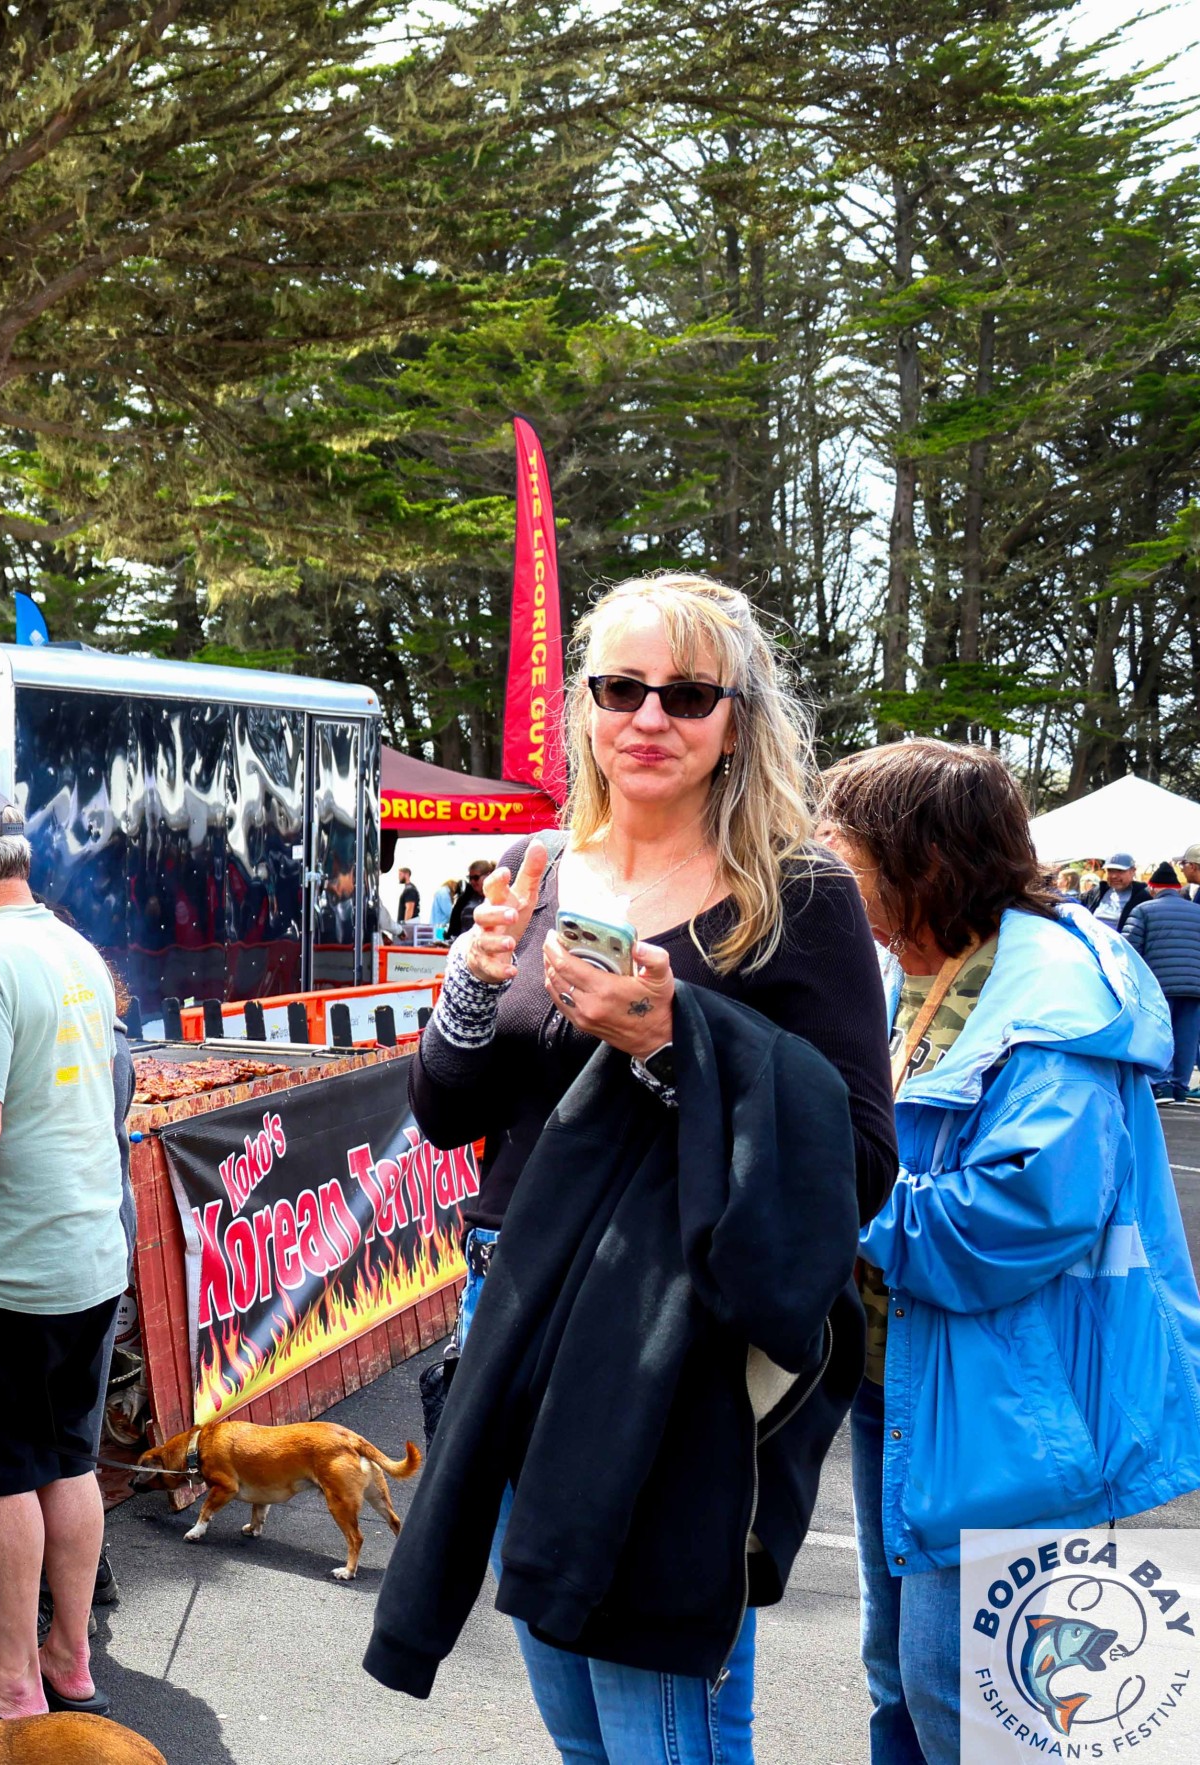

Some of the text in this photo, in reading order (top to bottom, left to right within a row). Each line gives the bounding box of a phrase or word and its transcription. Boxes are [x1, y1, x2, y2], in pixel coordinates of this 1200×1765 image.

[527, 448, 543, 519] THE
[530, 528, 548, 686] LICORICE
[380, 797, 452, 820] ORICE
[219, 1111, 286, 1217] Koko's
[192, 1125, 480, 1329] Korean Teriyak
